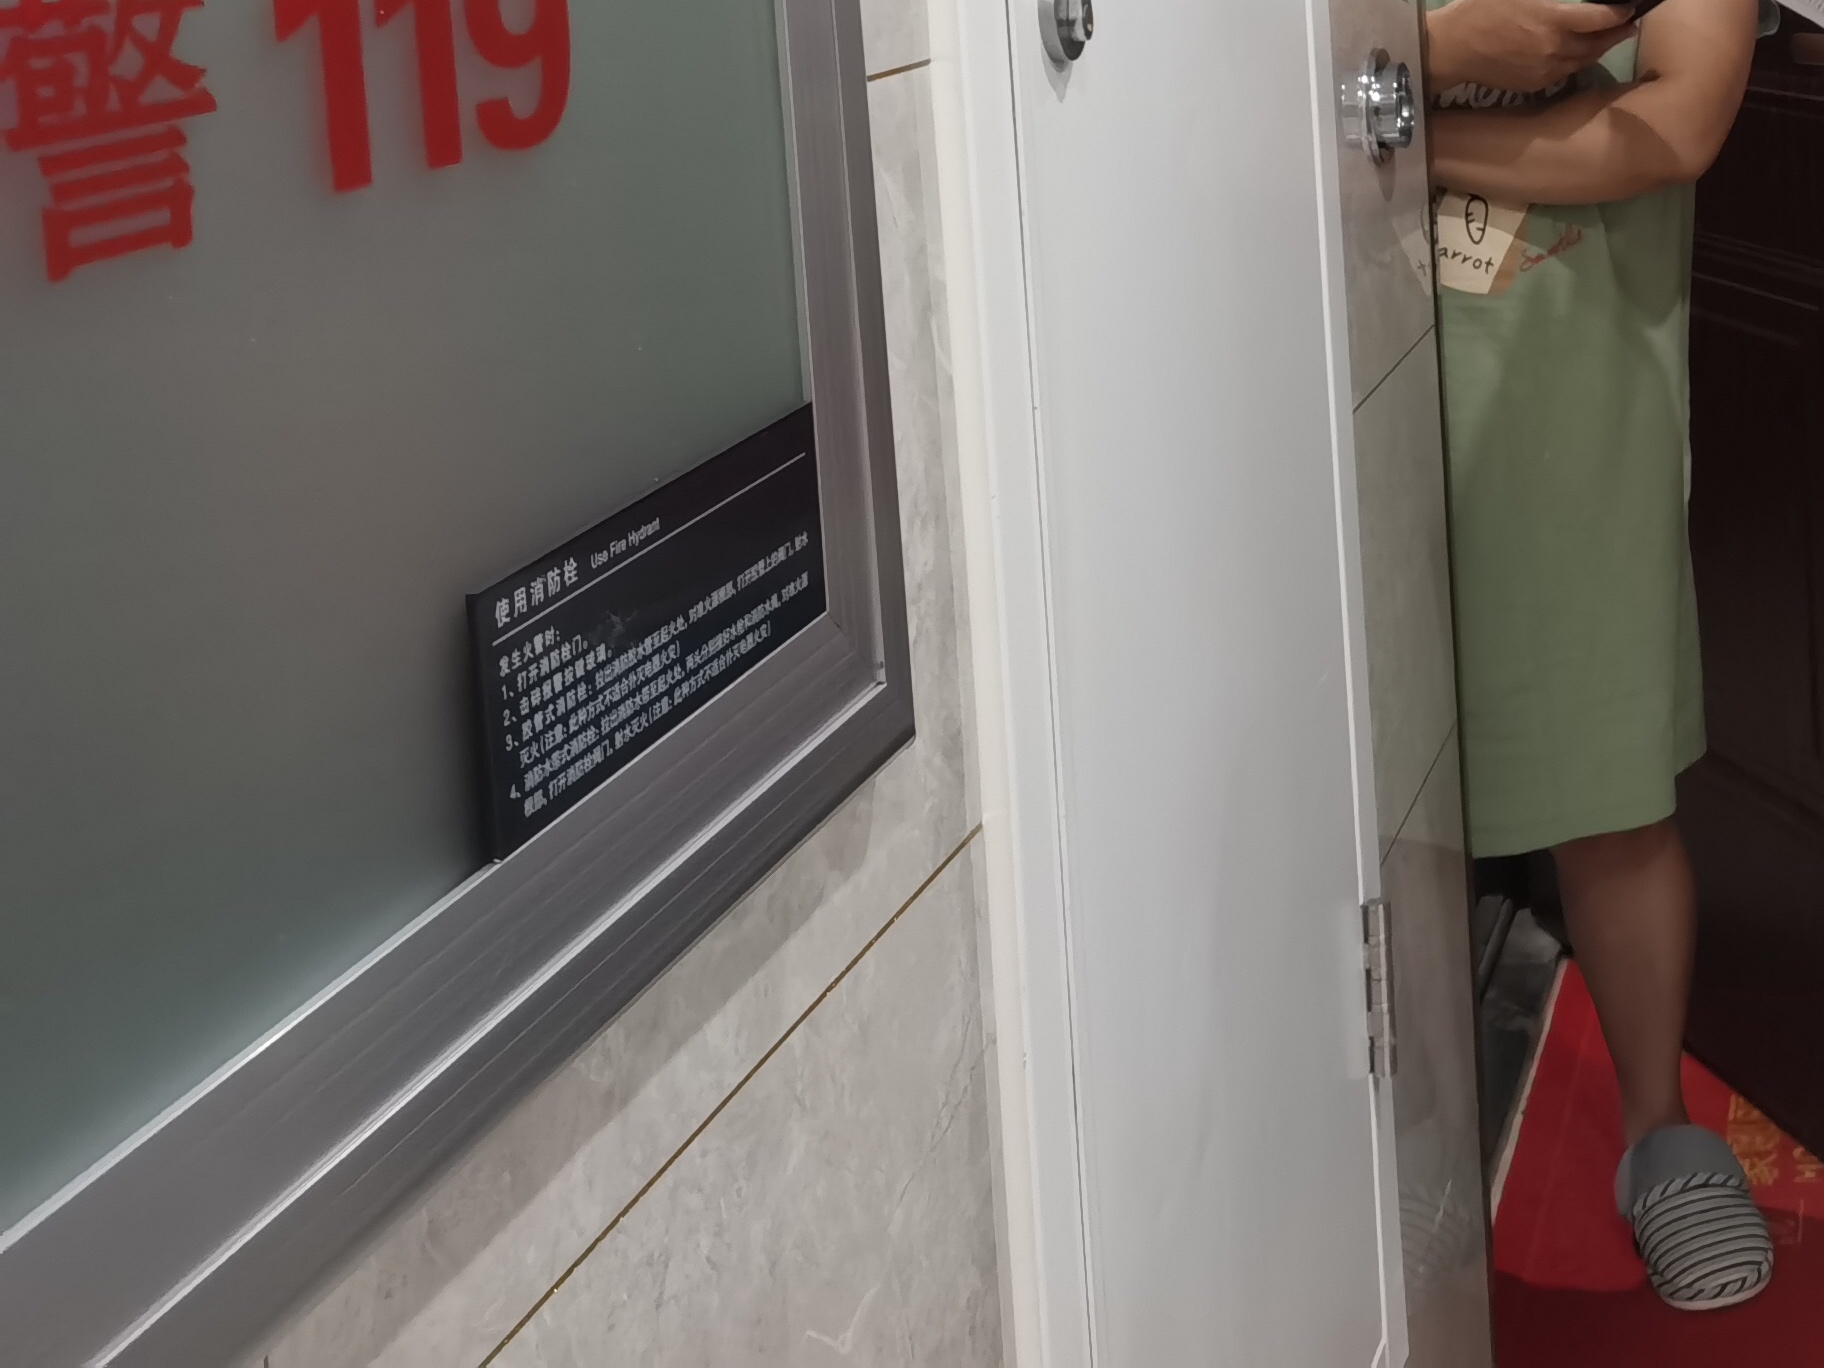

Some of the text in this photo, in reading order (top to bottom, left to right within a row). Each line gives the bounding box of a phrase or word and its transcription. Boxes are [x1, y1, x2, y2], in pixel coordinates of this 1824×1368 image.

[494, 517, 661, 628] 使用消防栓 Use Fire Hydrant
